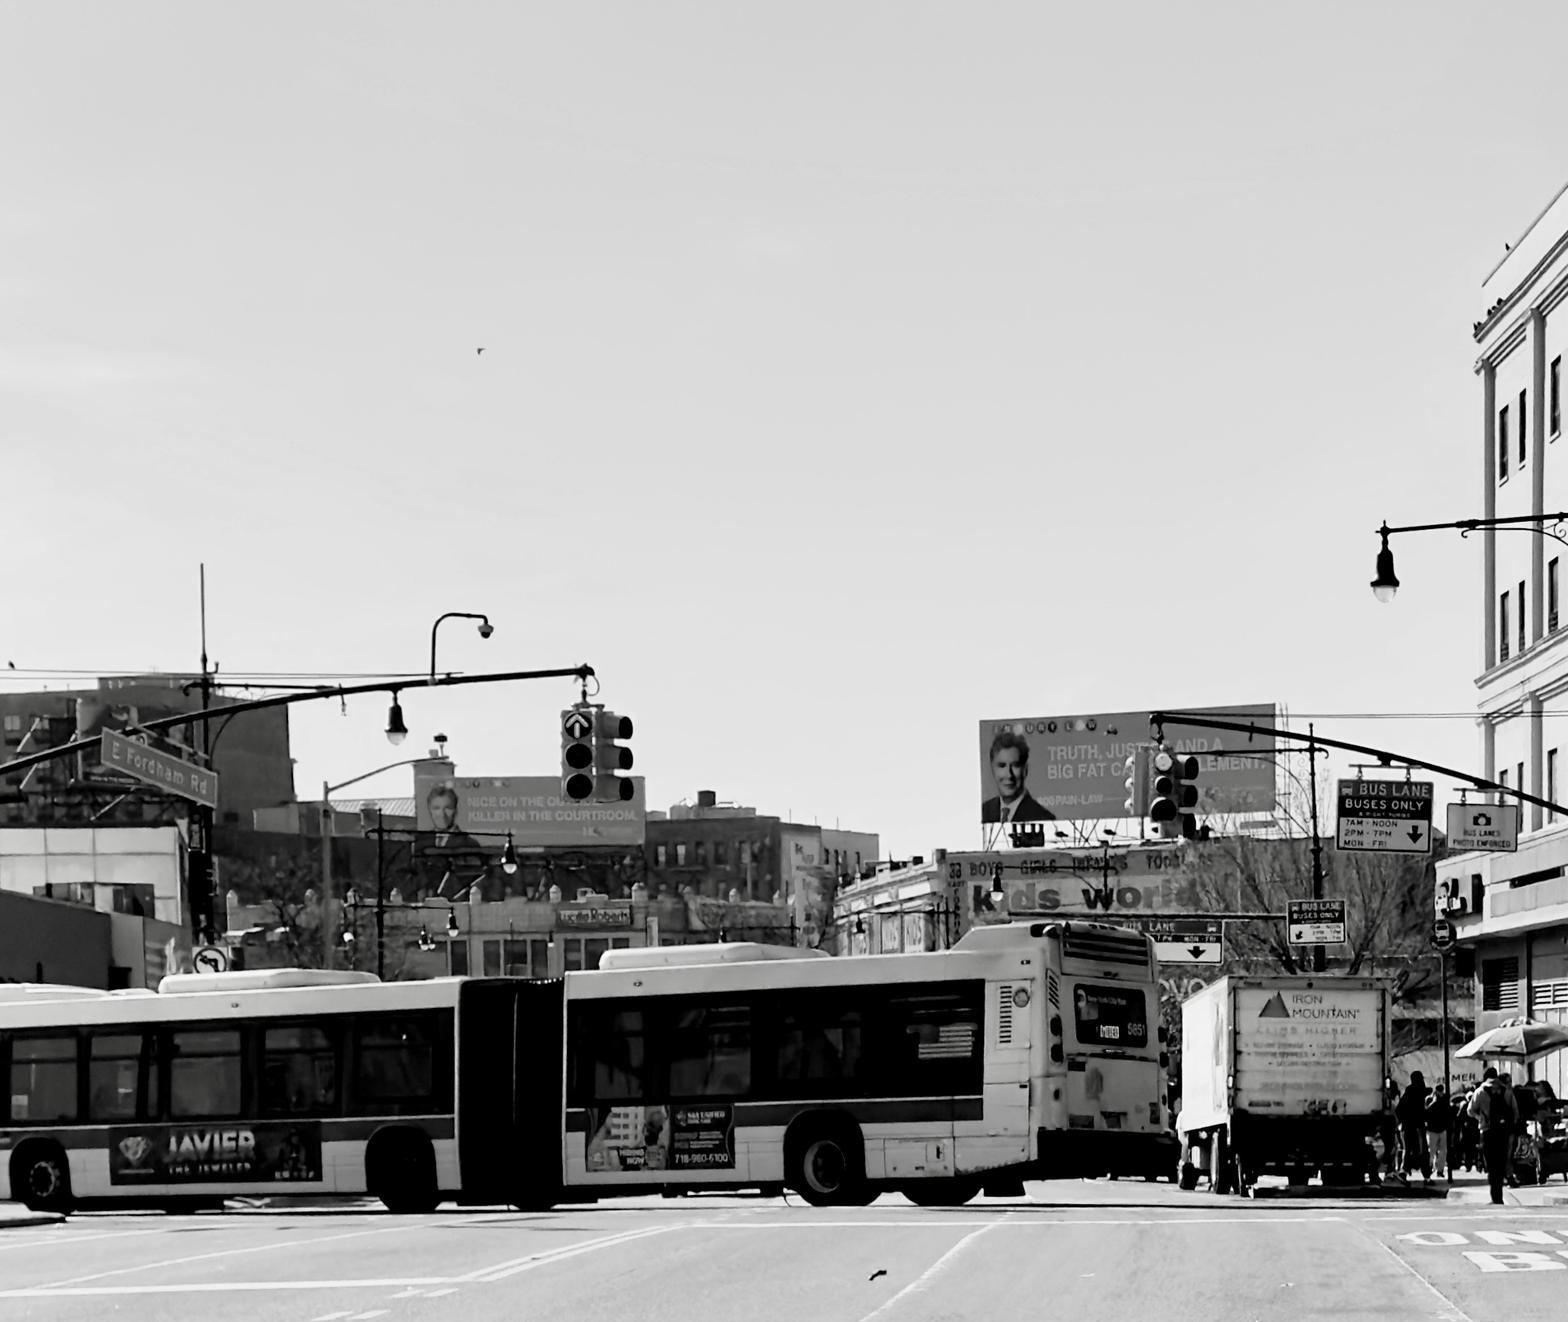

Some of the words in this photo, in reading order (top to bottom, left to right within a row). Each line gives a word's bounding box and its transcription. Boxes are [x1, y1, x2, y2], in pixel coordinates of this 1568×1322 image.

[1048, 744, 1102, 761] TRUTH,
[1176, 738, 1207, 752] AND
[1214, 737, 1223, 750] A
[111, 741, 120, 760] E
[126, 747, 184, 785] Fordham
[191, 774, 207, 794] Rd
[1047, 764, 1073, 779] BIG
[1078, 762, 1107, 777] FAT
[1360, 783, 1388, 795] BUS
[1392, 784, 1430, 797] LANE
[522, 797, 547, 807] THE
[1345, 798, 1387, 809] BUSES
[1391, 801, 1424, 810] ONLY
[468, 811, 512, 822] KILLER
[530, 811, 551, 821] THE
[555, 810, 638, 822] COURTROOM.
[1344, 829, 1363, 837] 2PM
[1149, 922, 1175, 932] LANE
[1292, 994, 1322, 1004] IRON
[168, 1130, 256, 1161] JAVIER
[626, 1157, 645, 1170] NOW
